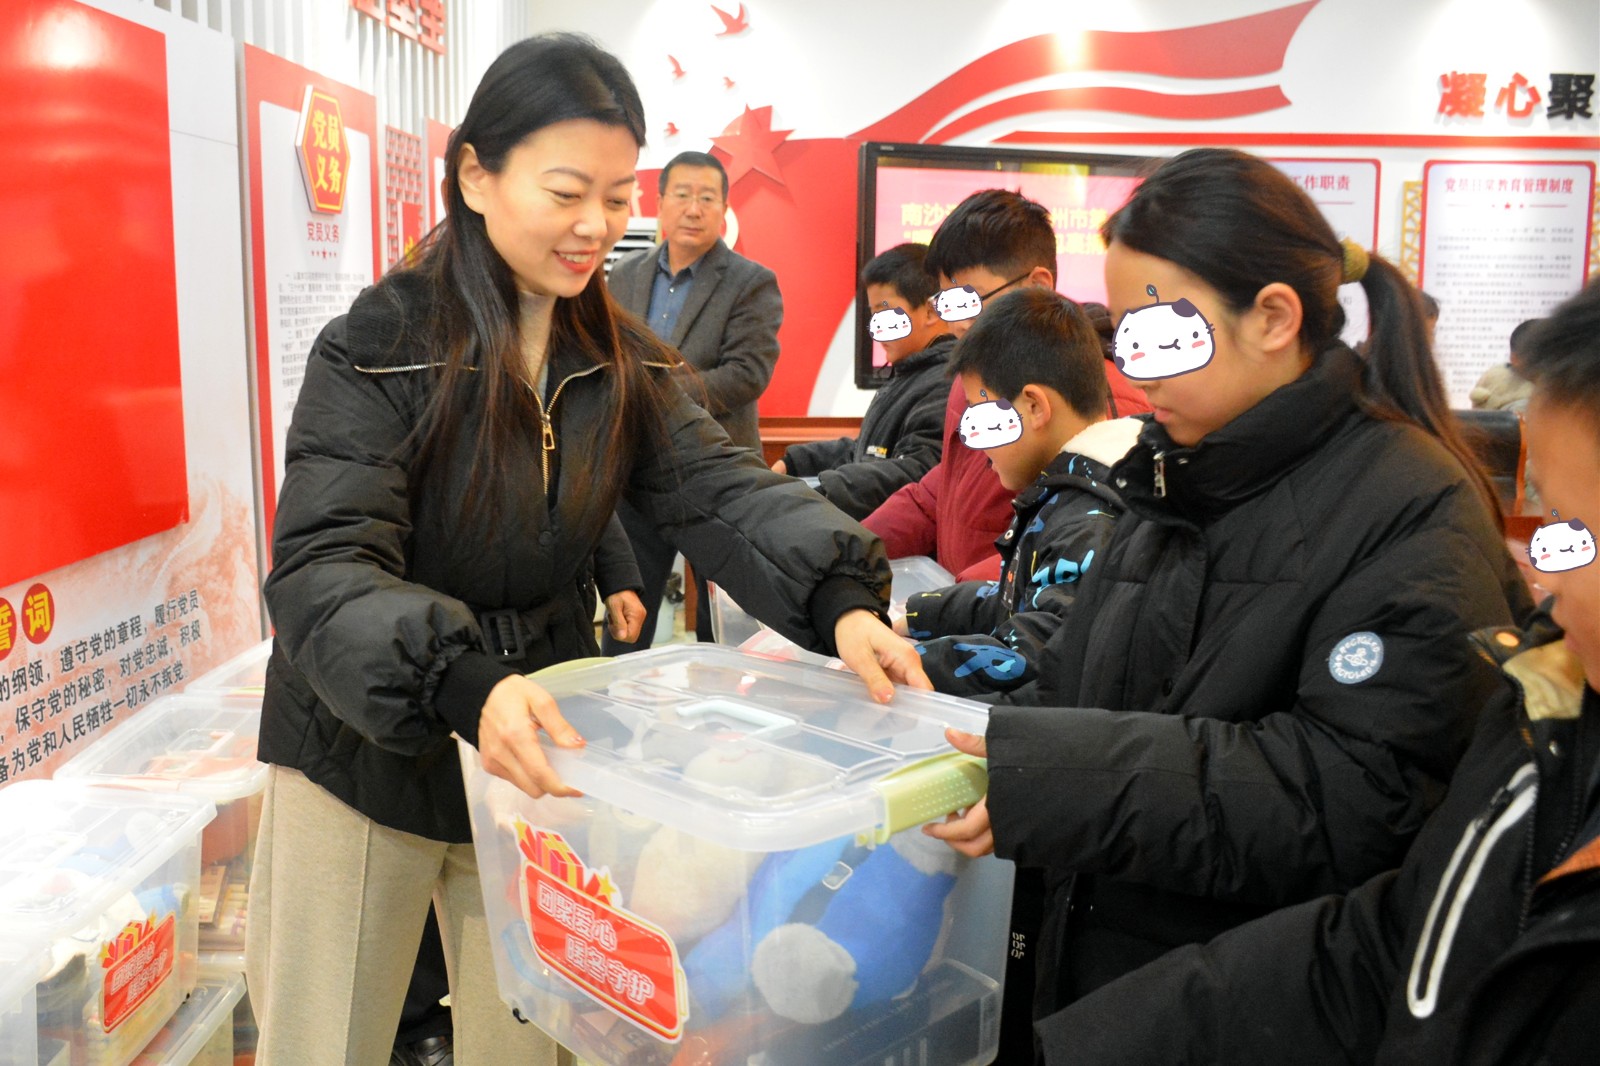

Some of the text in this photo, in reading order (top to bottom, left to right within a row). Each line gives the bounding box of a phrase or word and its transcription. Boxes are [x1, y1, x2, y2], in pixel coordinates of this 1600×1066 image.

[1437, 71, 1596, 120] 凝心聚
[312, 109, 340, 153] 党员
[315, 154, 342, 194] 义务
[307, 221, 340, 243] 党员义务
